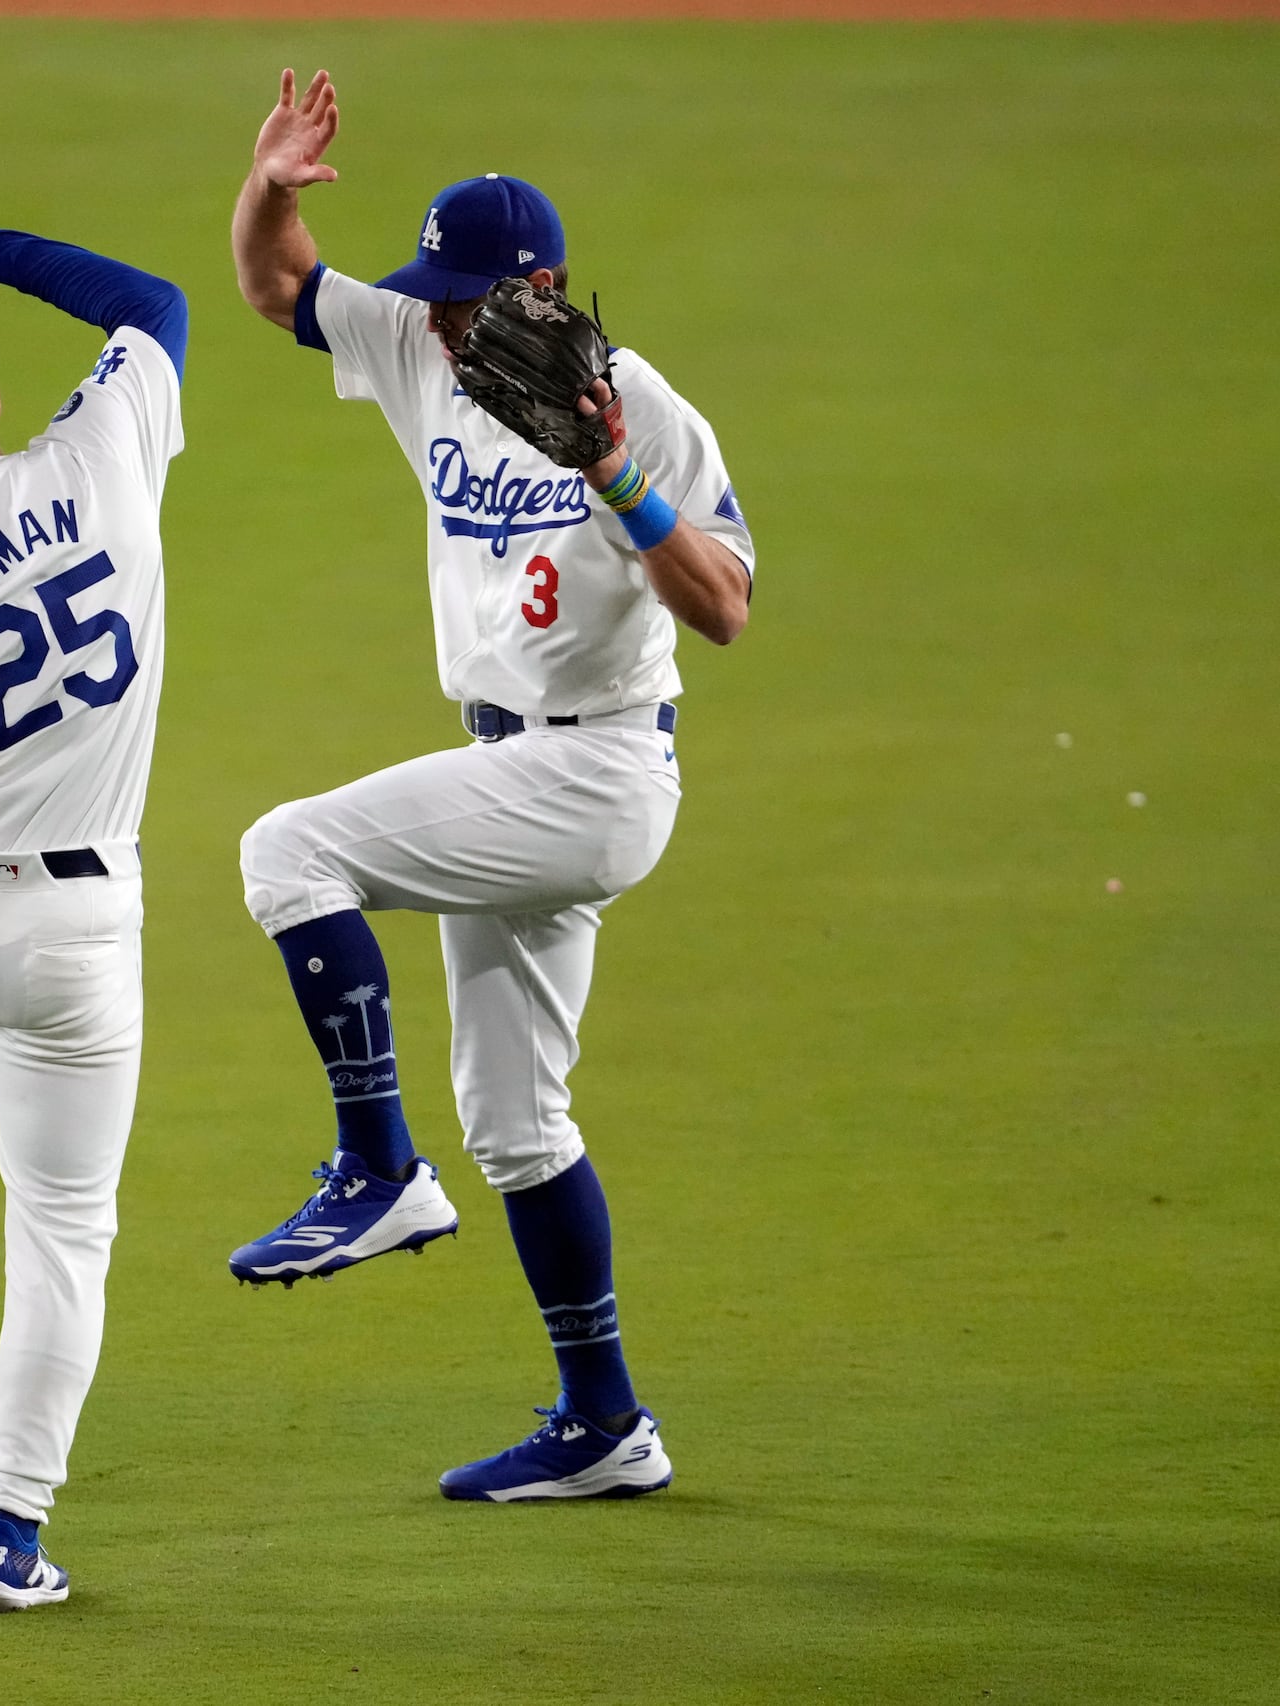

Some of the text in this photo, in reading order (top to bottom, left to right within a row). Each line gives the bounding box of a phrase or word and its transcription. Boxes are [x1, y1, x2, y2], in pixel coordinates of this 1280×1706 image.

[422, 207, 443, 252] LA
[430, 438, 592, 559] Dodgers
[521, 555, 559, 629] 3
